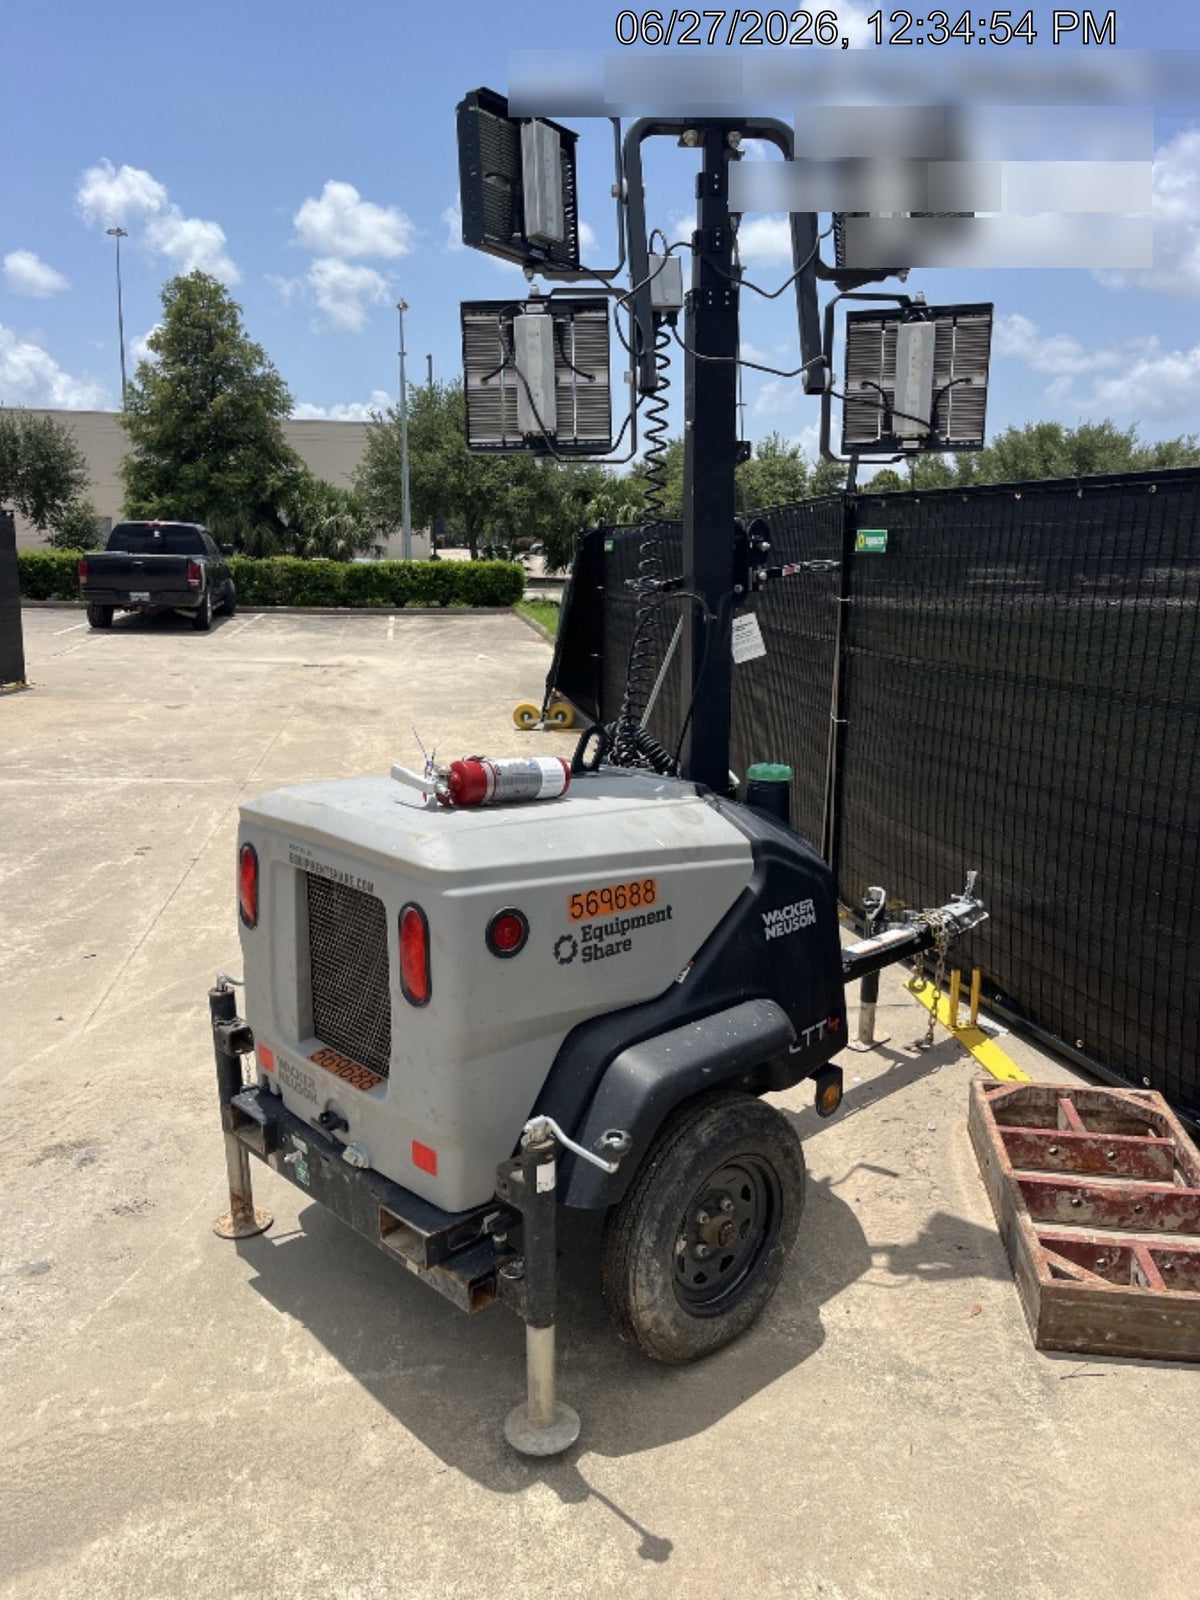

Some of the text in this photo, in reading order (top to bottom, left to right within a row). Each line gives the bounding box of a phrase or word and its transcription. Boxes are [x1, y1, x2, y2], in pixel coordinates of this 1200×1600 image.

[570, 879, 656, 919] 569688
[761, 898, 815, 925] WACKER
[581, 904, 673, 943] Equipment
[764, 911, 817, 940] NEUSON
[581, 937, 632, 964] Share
